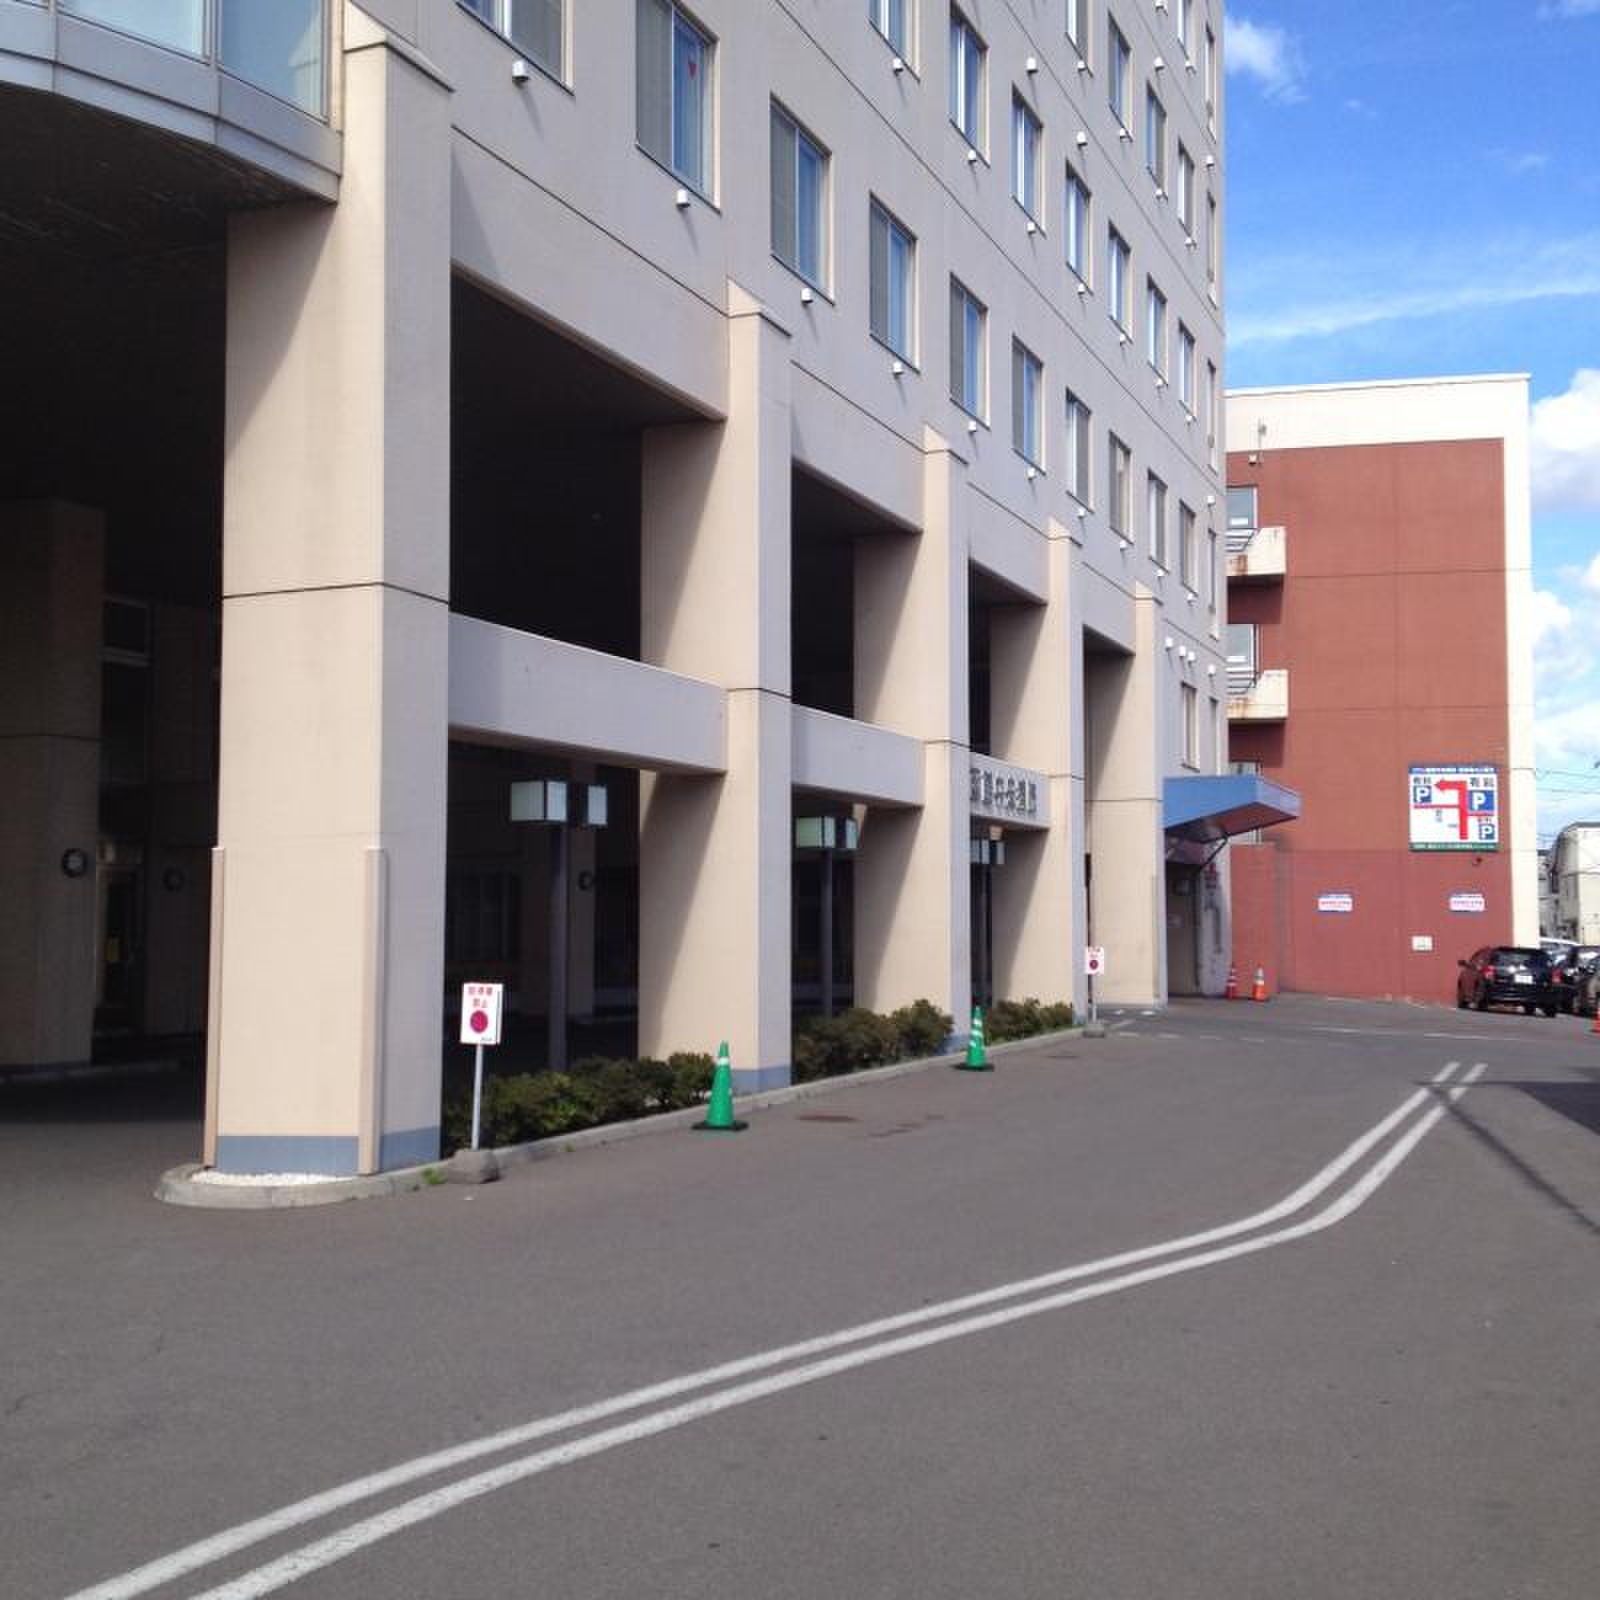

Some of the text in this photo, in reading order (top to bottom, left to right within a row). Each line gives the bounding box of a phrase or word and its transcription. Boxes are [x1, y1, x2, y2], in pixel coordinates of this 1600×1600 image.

[1416, 785, 1430, 803] P
[1472, 791, 1487, 811] P
[1481, 825, 1494, 840] P
